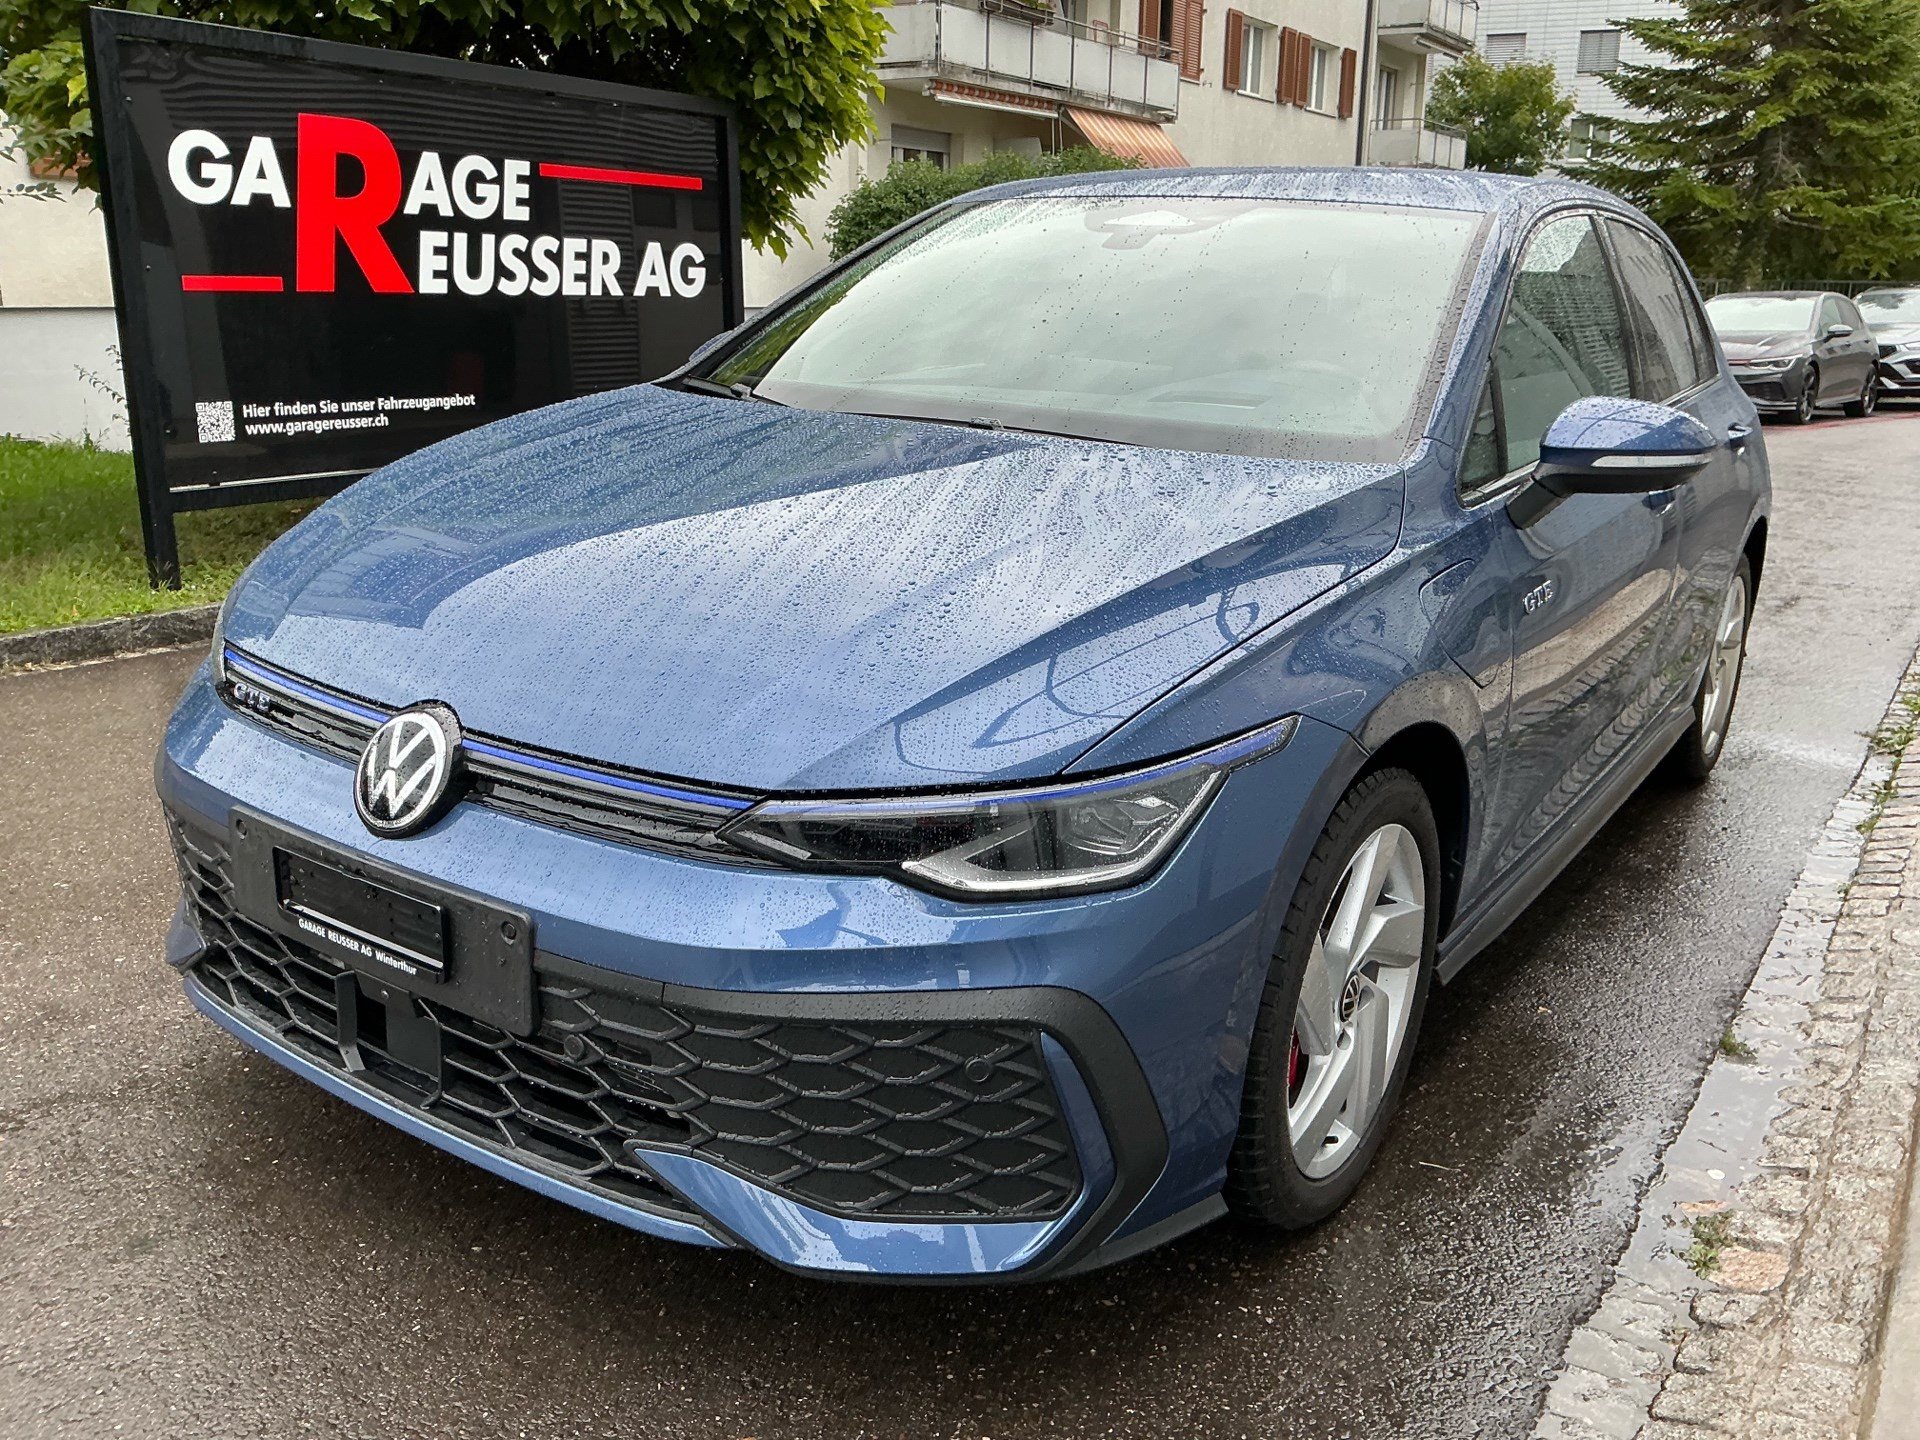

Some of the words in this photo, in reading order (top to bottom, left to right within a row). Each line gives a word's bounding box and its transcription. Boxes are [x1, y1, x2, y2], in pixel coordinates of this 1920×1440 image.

[633, 241, 706, 298] AG
[243, 403, 271, 418] Hier
[274, 401, 317, 417] finden
[319, 400, 339, 414] Sie
[341, 398, 375, 414] unser
[377, 393, 476, 412] Fahrzeugangebot
[245, 413, 389, 436] www.garagereusser.ch
[298, 918, 326, 938] GARAGE
[327, 930, 360, 952] REUSSER
[360, 944, 373, 957] AG
[375, 949, 417, 976] Winterthur
